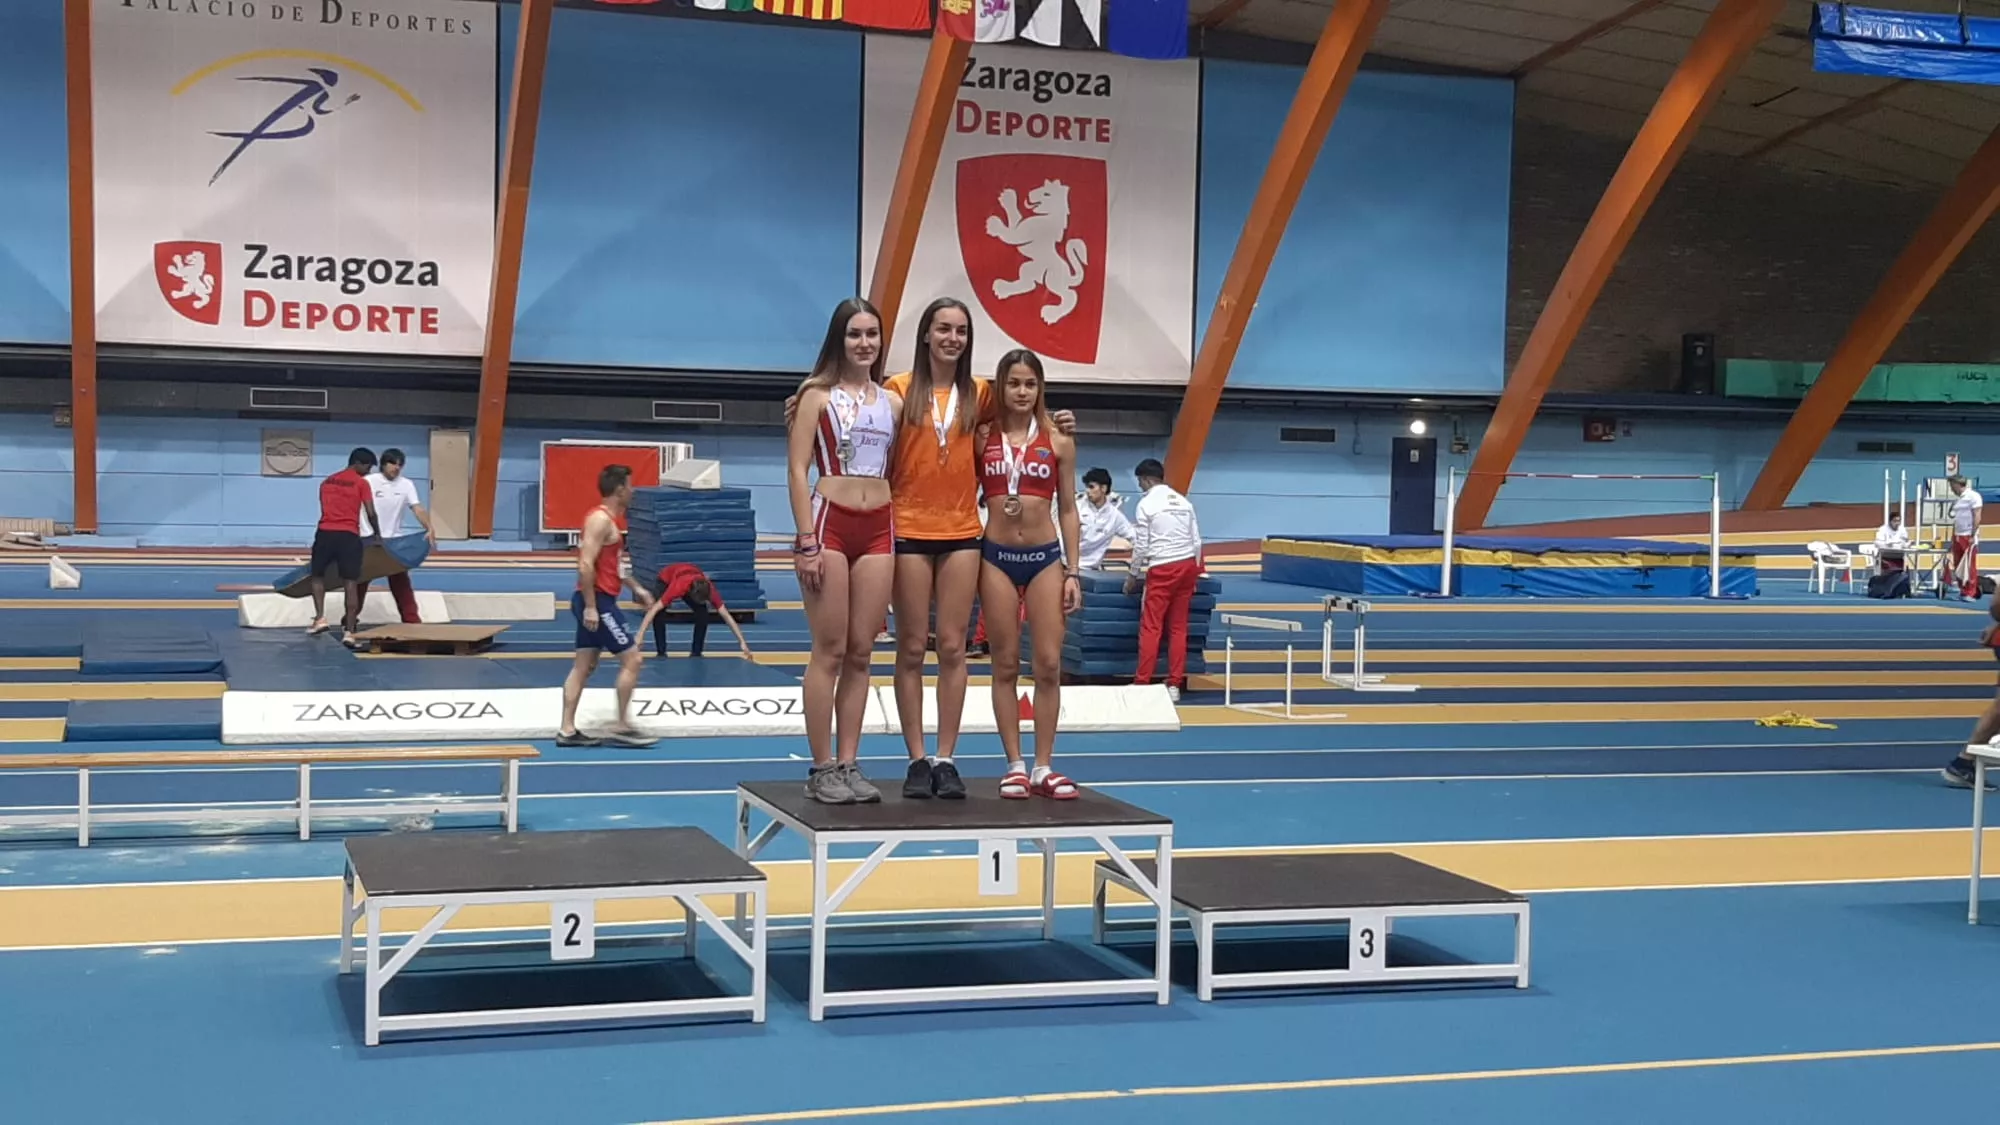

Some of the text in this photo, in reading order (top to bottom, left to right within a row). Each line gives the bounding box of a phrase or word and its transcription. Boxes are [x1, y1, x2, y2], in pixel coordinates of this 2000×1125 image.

[121, 0, 472, 34] ALACIO DE DEPORTES
[959, 57, 1112, 103] Zaragoza
[956, 99, 1111, 143] DEPORTE
[243, 243, 439, 295] Zaragoza
[243, 289, 439, 334] DEPORTE
[1947, 453, 1957, 472] 3
[292, 702, 504, 721] ZARAGOZA
[631, 697, 806, 717] ZARAGOZ
[991, 850, 1001, 882] 1
[563, 912, 581, 946] 2
[1359, 928, 1374, 958] 3
